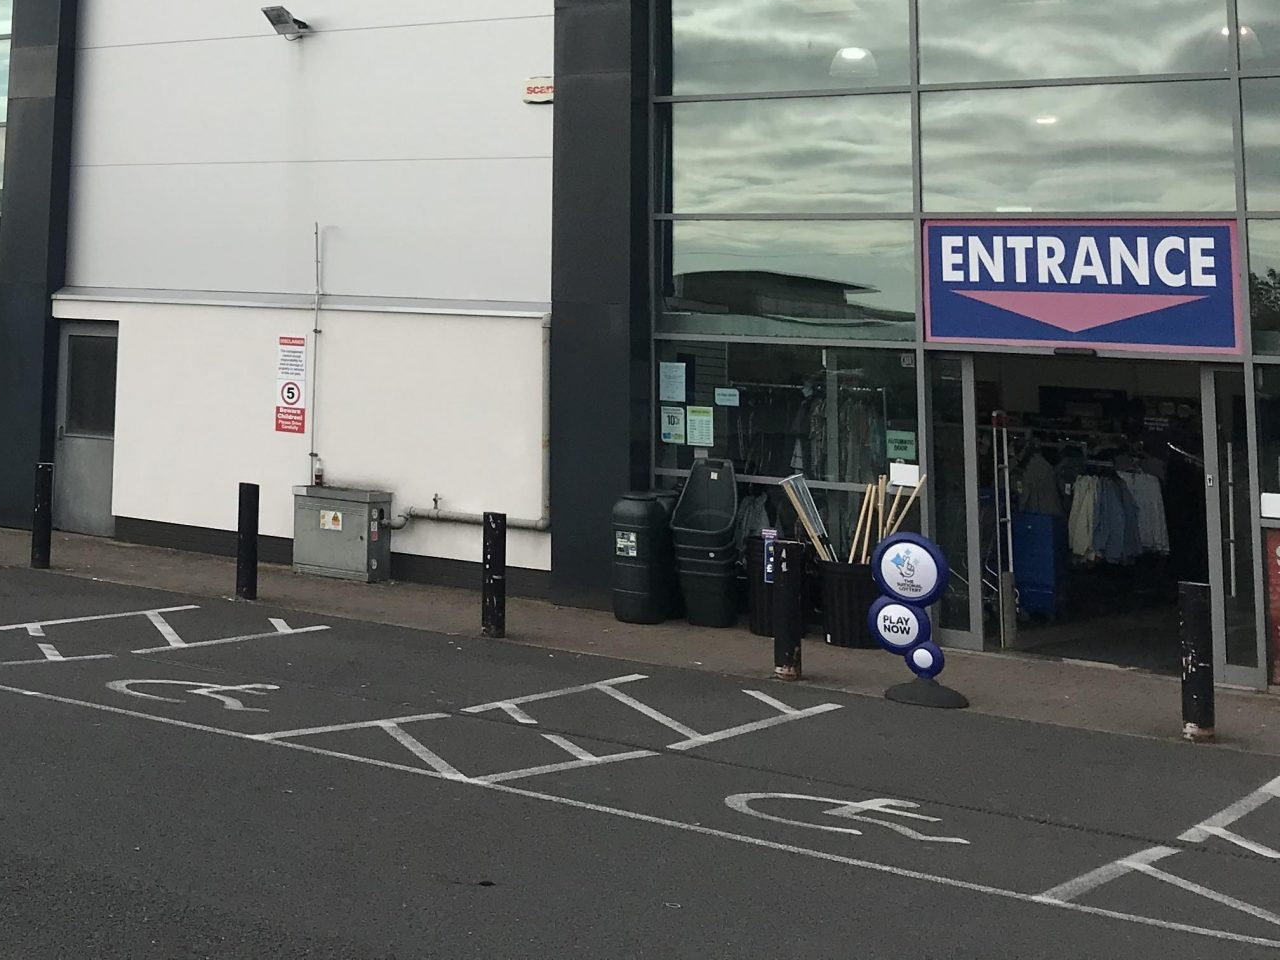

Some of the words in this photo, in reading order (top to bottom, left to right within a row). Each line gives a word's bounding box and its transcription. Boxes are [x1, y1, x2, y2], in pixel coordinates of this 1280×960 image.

[941, 235, 1217, 288] ENTRANCE
[286, 387, 295, 400] 5
[883, 615, 910, 626] PLAY
[883, 624, 911, 635] NOW
